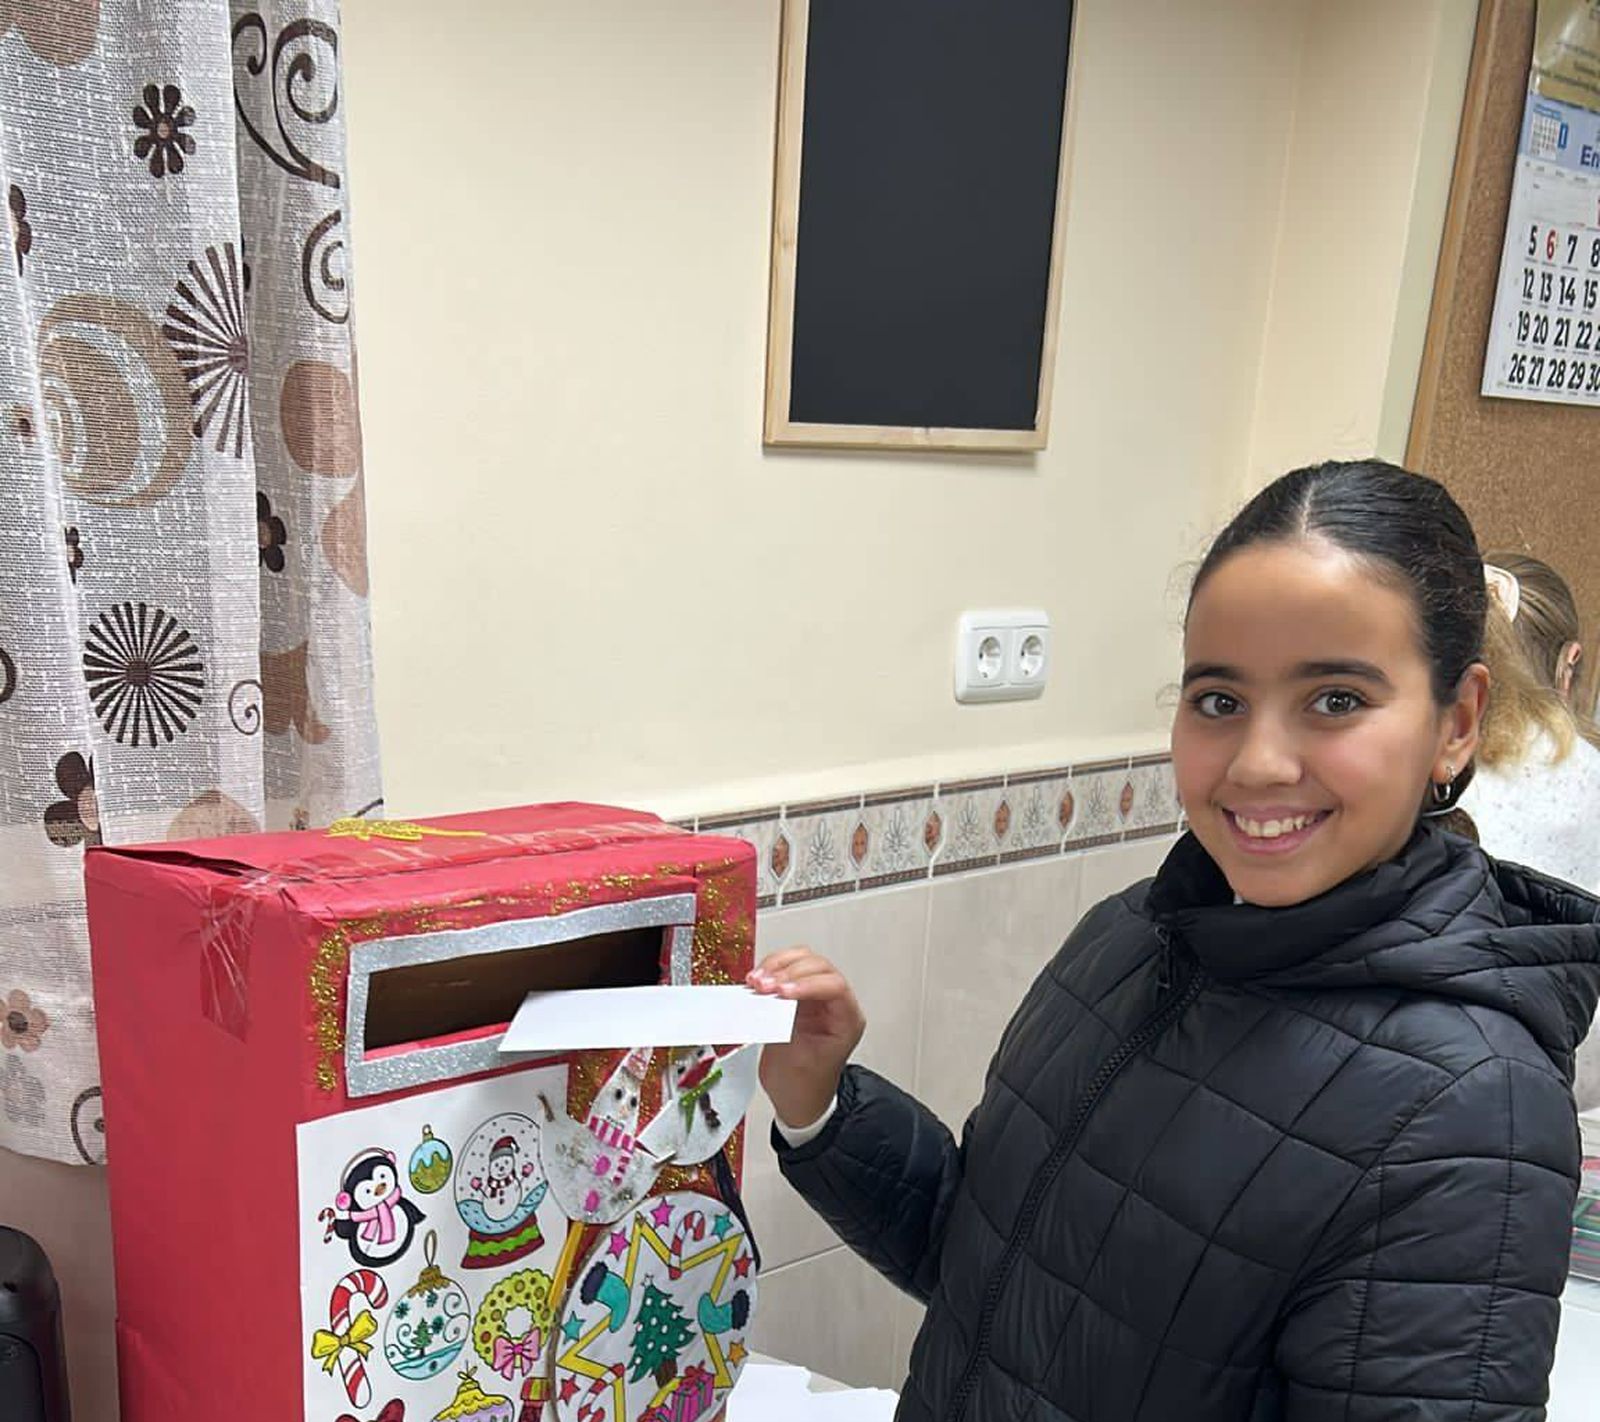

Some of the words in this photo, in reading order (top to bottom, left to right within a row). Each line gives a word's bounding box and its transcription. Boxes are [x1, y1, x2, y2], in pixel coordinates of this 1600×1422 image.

[1528, 225, 1538, 256] 5
[1546, 230, 1556, 260] 6
[1567, 234, 1578, 264] 7
[1590, 238, 1600, 268] 8
[1522, 268, 1535, 299] 12
[1539, 272, 1552, 303] 13
[1559, 276, 1576, 306] 14
[1583, 279, 1598, 309] 15
[1517, 311, 1530, 342] 19
[1532, 314, 1548, 345] 20
[1553, 318, 1570, 348] 21
[1575, 320, 1593, 350] 22
[1508, 353, 1527, 385] 26
[1528, 356, 1545, 387] 27
[1547, 358, 1566, 389] 28
[1567, 361, 1585, 391] 29
[1585, 363, 1600, 392] 30
